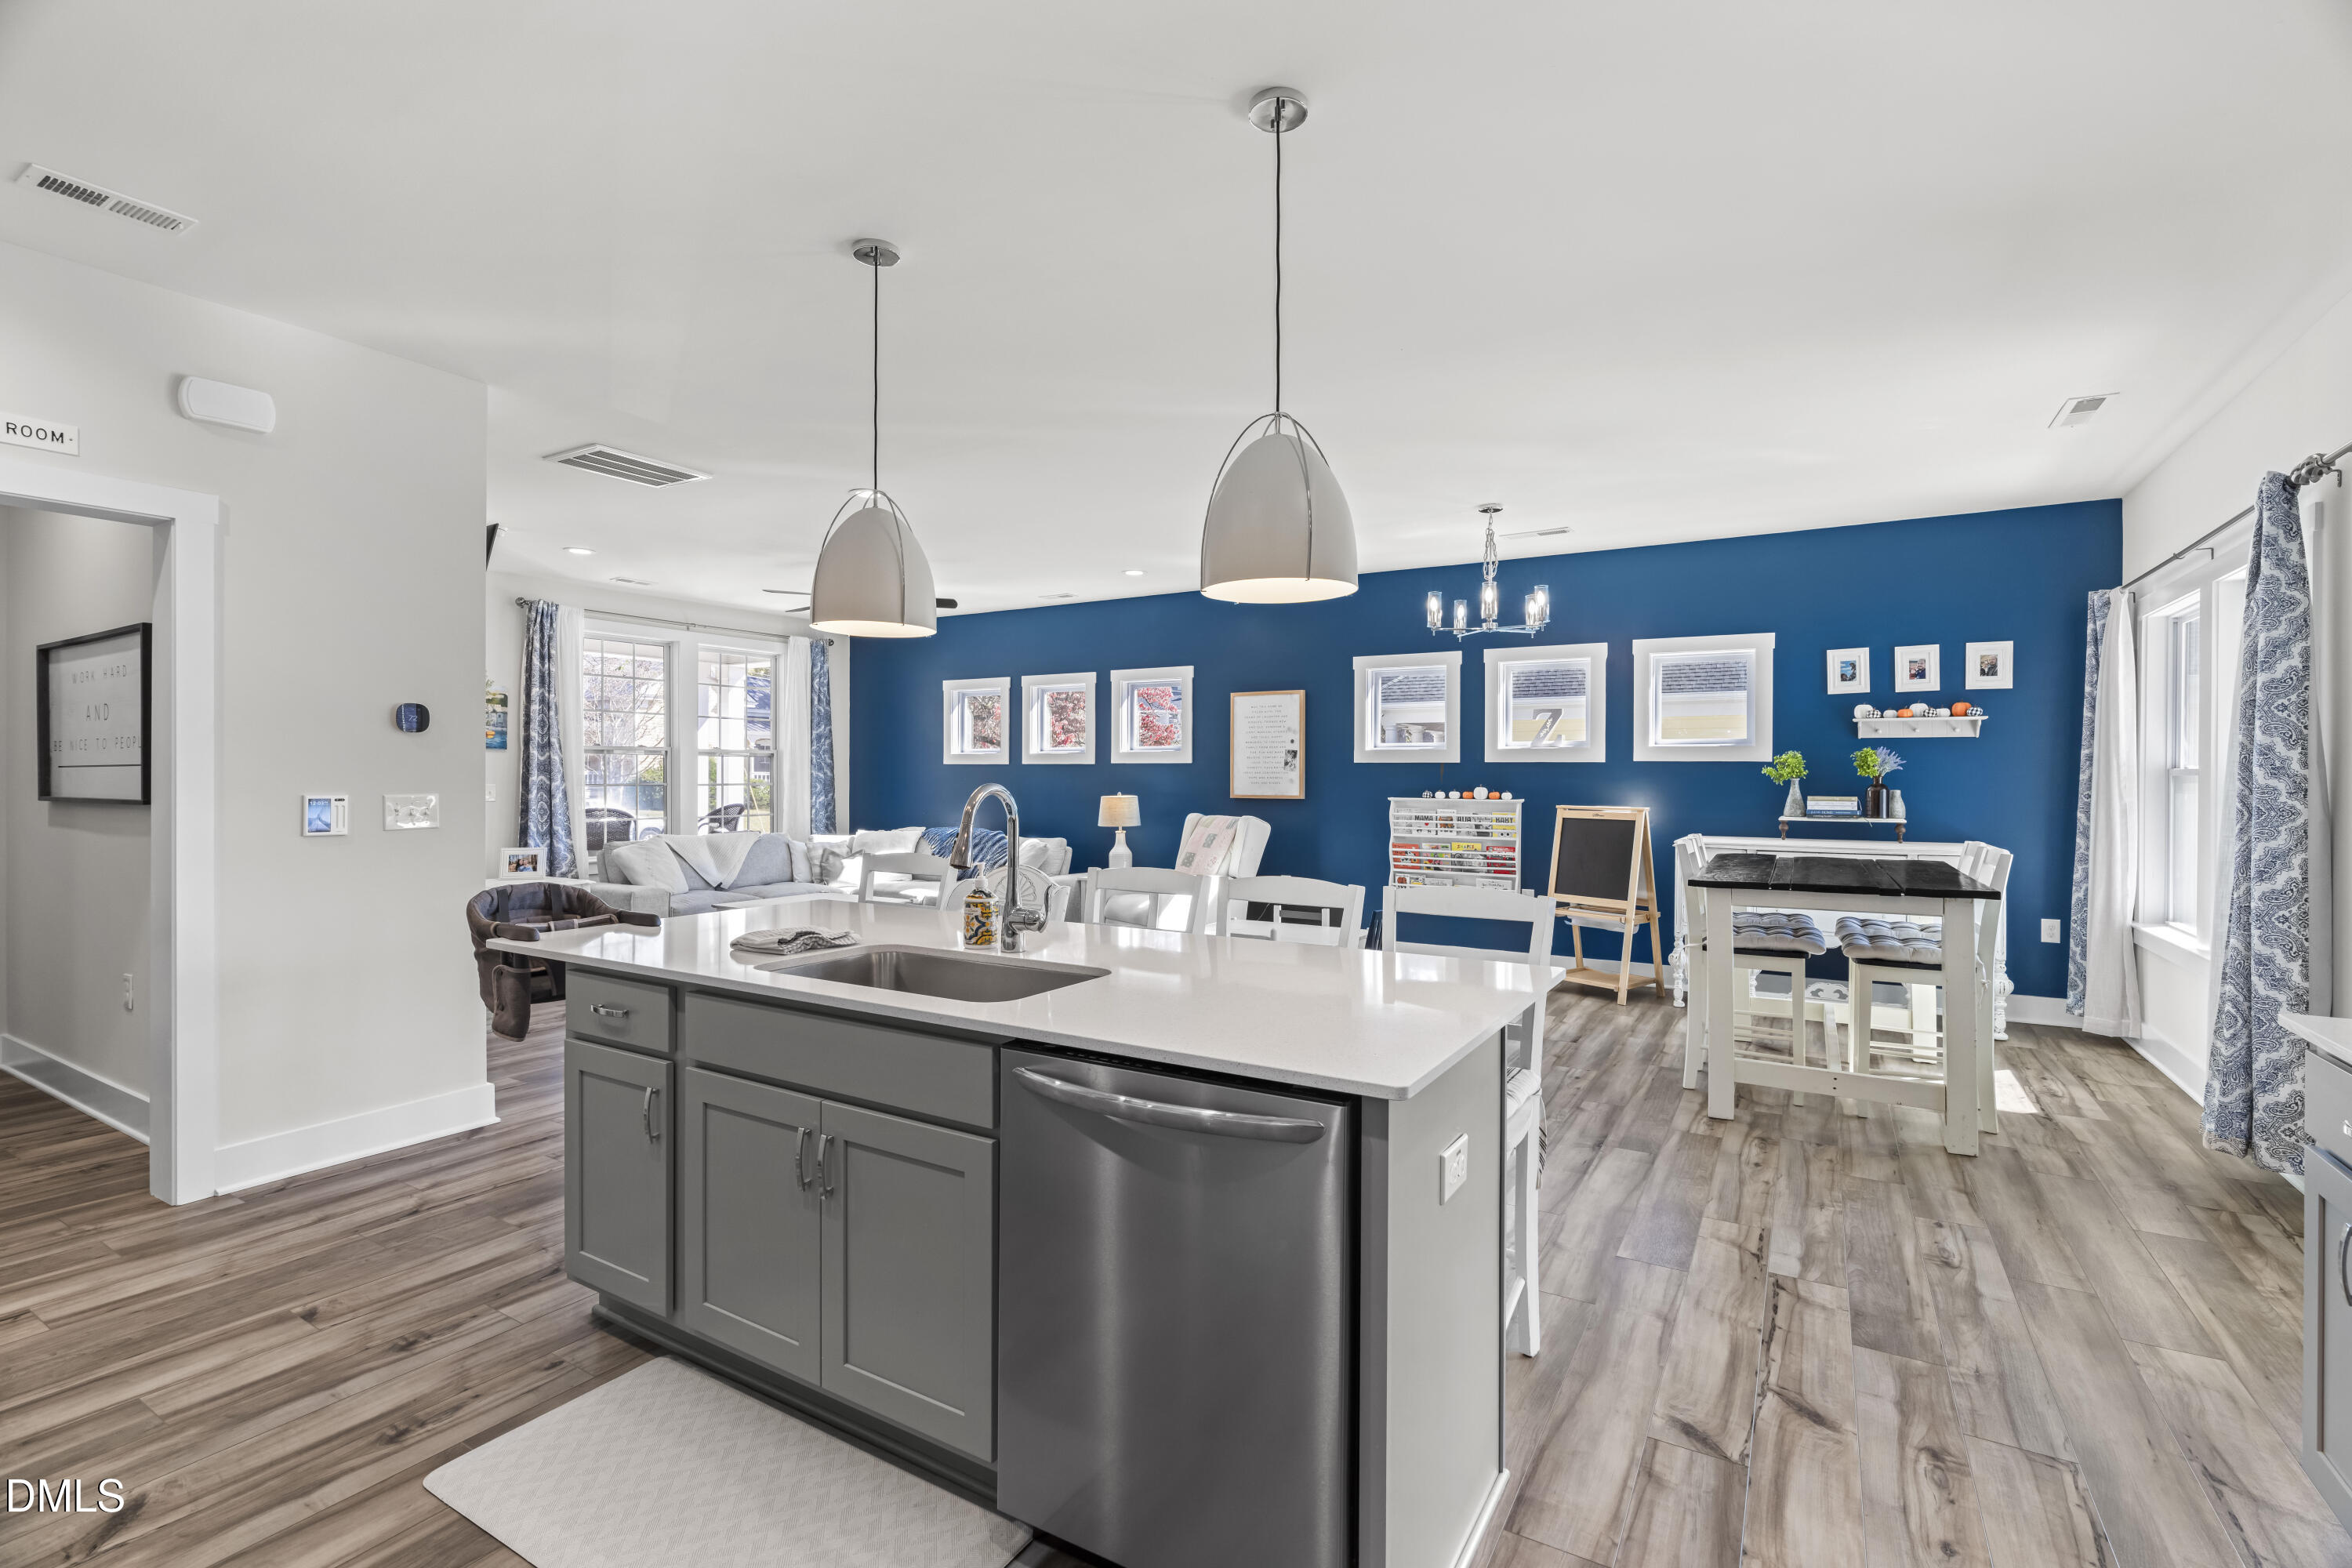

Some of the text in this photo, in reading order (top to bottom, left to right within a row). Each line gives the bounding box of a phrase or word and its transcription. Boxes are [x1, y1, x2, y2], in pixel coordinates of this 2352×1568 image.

[5, 422, 64, 444] ROOM
[72, 665, 127, 684] WORK HARD
[85, 702, 110, 721] AND
[69, 739, 88, 751] NICE
[96, 738, 107, 750] TO
